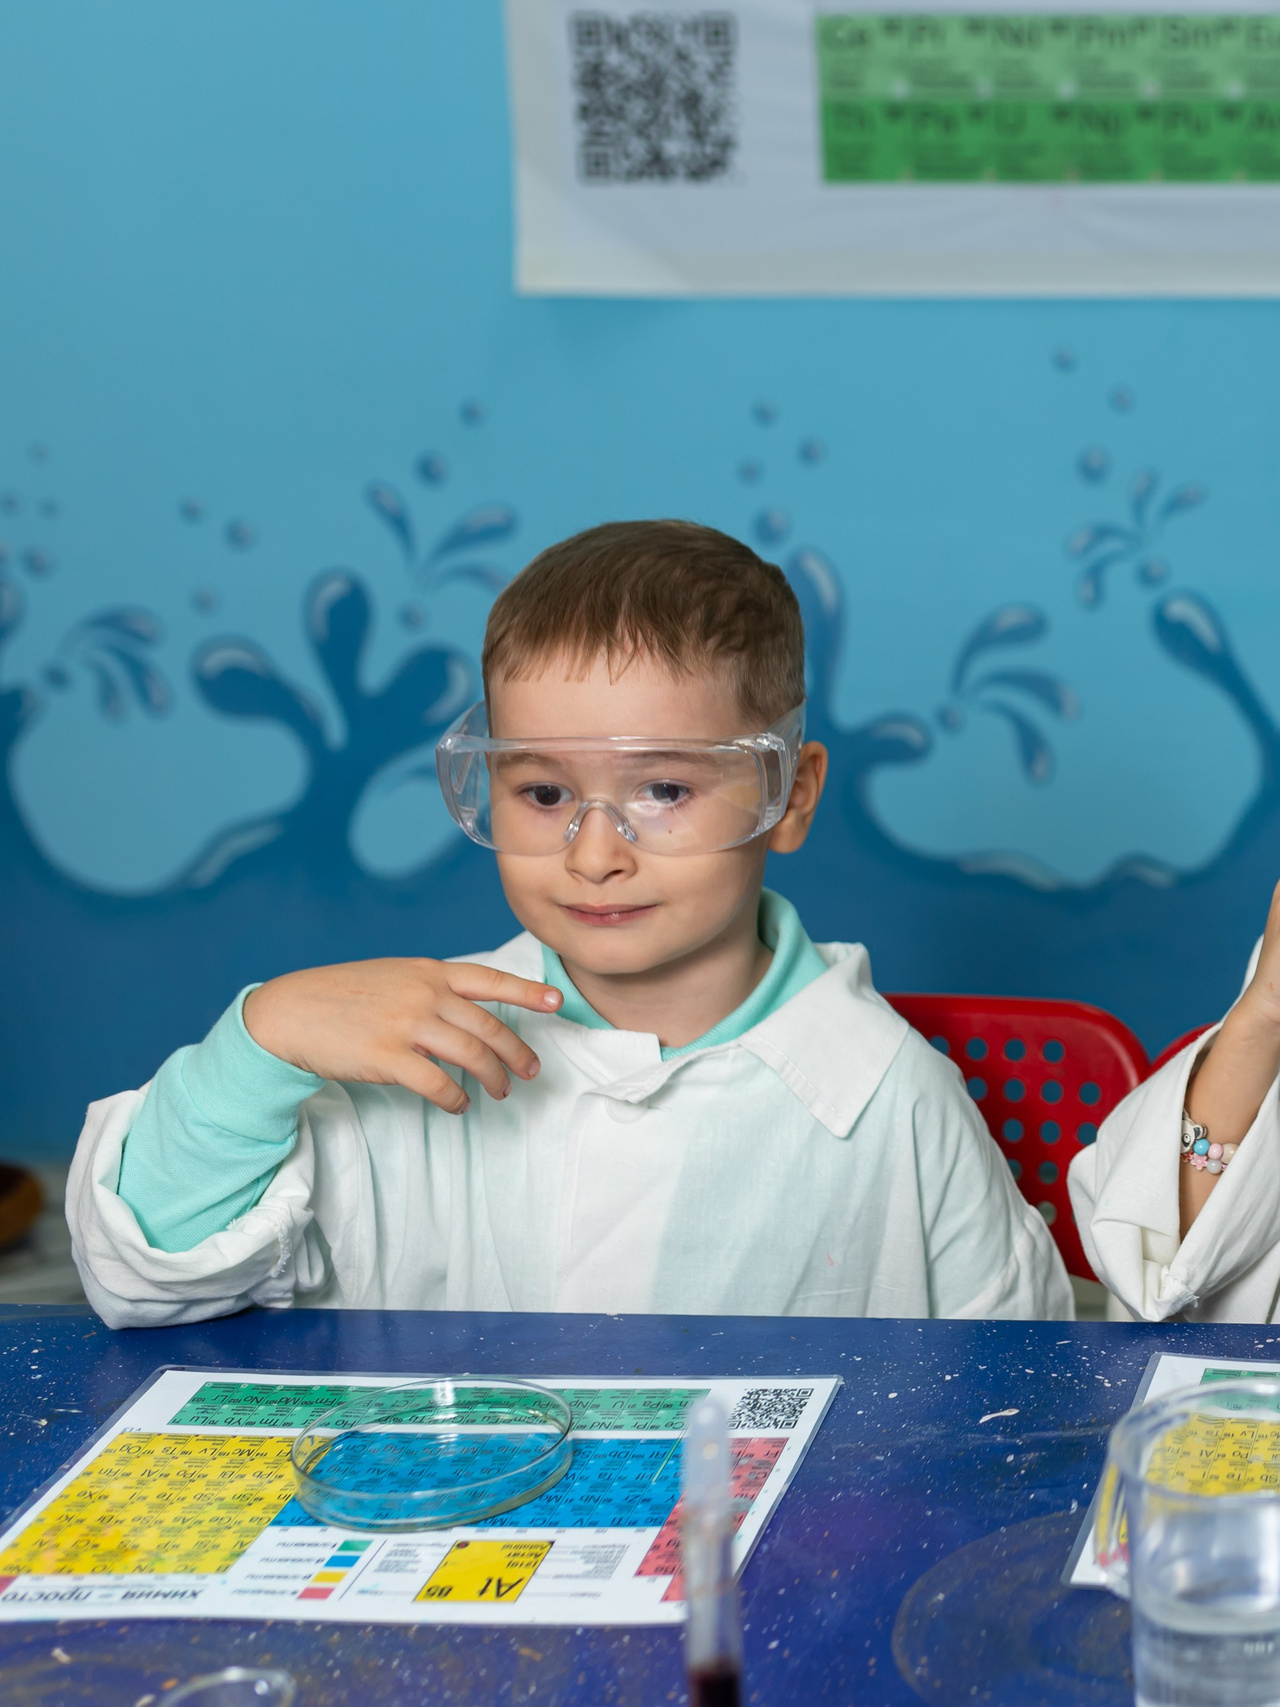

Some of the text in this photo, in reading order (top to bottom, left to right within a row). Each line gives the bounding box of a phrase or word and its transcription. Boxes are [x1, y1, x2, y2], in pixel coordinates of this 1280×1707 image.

[213, 1394, 228, 1403] Lr
[243, 1395, 265, 1404] No
[278, 1396, 300, 1405] Md
[314, 1397, 337, 1406] Fm
[568, 1399, 590, 1409] Np
[612, 1400, 625, 1409] U
[642, 1400, 661, 1409] Pa
[189, 1415, 209, 1425] Lu
[224, 1416, 242, 1426] Yb
[259, 1417, 279, 1427] Tm
[335, 1419, 357, 1429] Ho
[590, 1421, 612, 1430] Nd
[632, 1421, 649, 1430] Pr
[664, 1421, 685, 1430] Ce
[1240, 1430, 1255, 1438] Lv
[119, 1443, 142, 1454] Og
[161, 1446, 177, 1455] Ts
[198, 1447, 217, 1456] Lv
[231, 1448, 255, 1457] Mc
[345, 1444, 367, 1453] Cn
[383, 1443, 405, 1453] Rg
[609, 1450, 630, 1459] Db
[648, 1450, 668, 1459] Rf
[1232, 1450, 1249, 1459] Po
[328, 1464, 349, 1475] Hg
[366, 1467, 388, 1476] Au
[176, 1470, 196, 1479] Po
[251, 1470, 273, 1479] Pb
[597, 1472, 613, 1481] Ta
[1226, 1472, 1242, 1481] Te
[1260, 1474, 1279, 1483] Sb
[76, 1490, 98, 1500] Xe
[156, 1492, 173, 1501] Te
[193, 1492, 214, 1501] Sb
[231, 1492, 253, 1501] Sn
[276, 1493, 292, 1501] In
[580, 1494, 601, 1503] Nb
[248, 1516, 271, 1525] Ga
[421, 1585, 454, 1599] 85
[475, 1576, 525, 1599] At
[1, 1587, 93, 1602] просто
